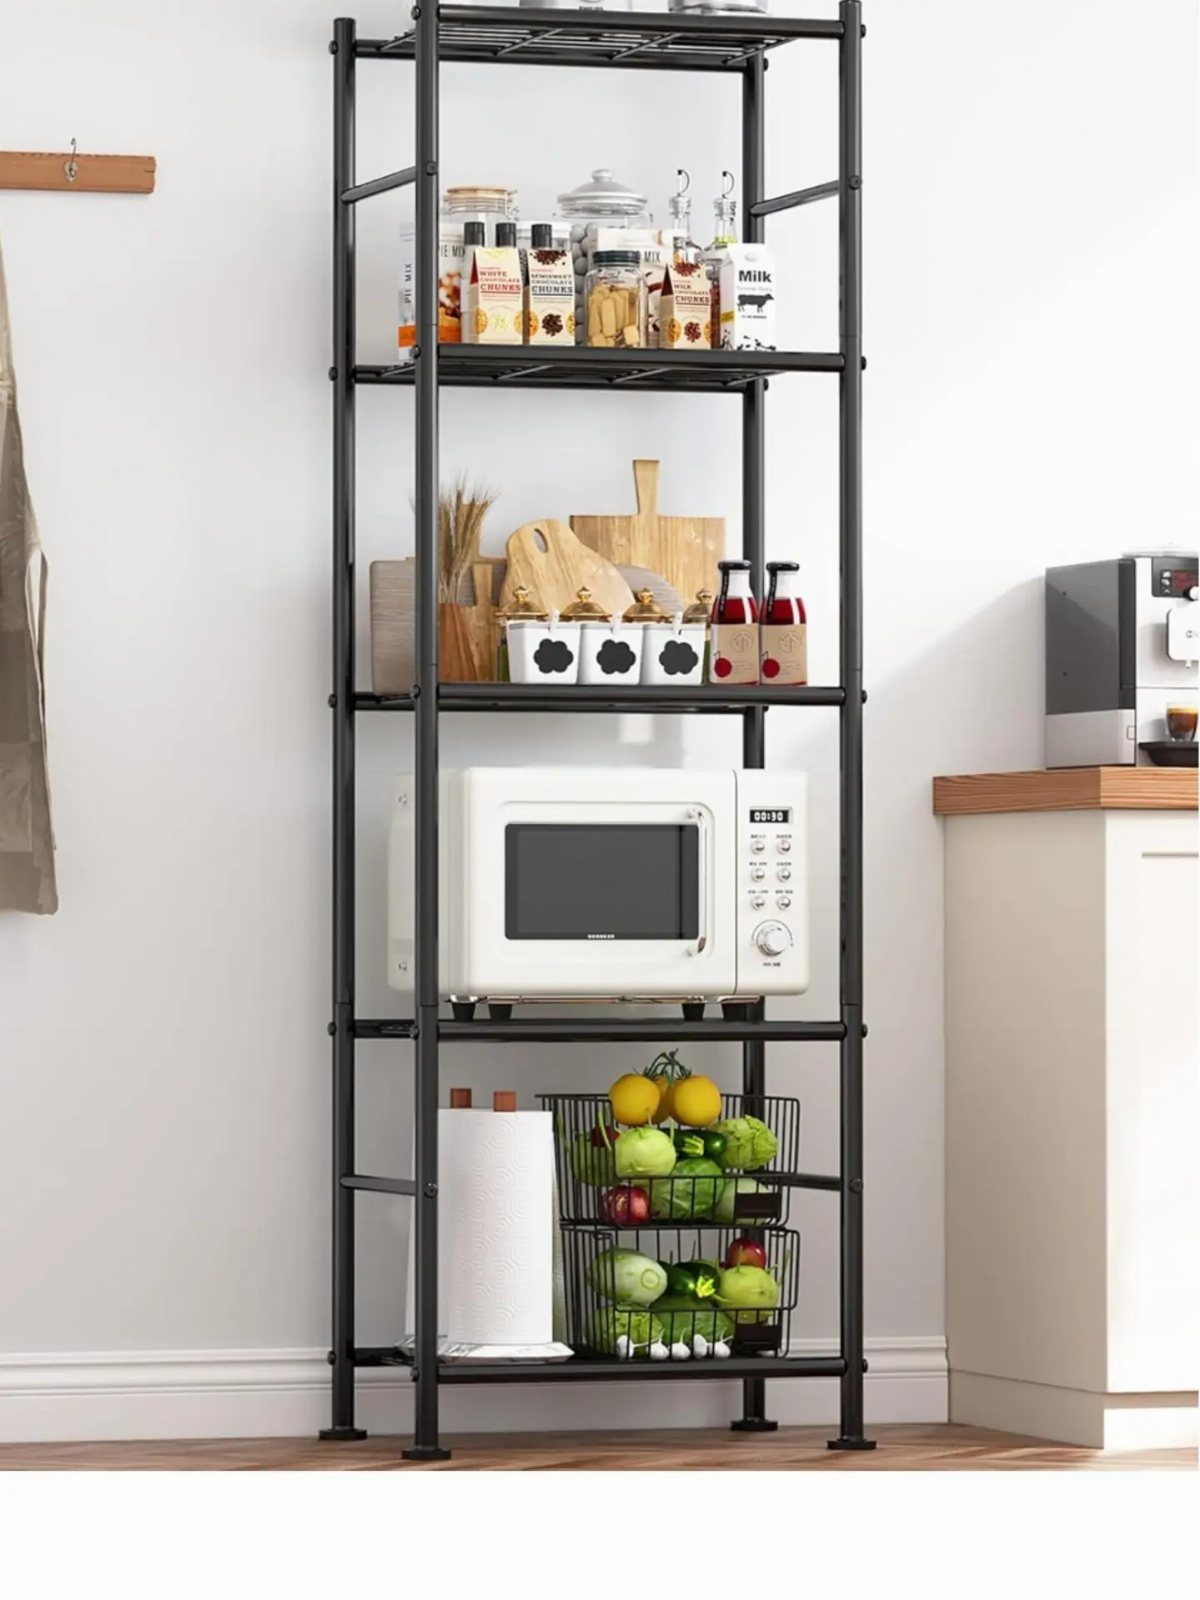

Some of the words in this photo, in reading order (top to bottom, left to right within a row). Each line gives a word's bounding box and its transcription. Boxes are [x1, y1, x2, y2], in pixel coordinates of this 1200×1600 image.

[644, 251, 662, 263] MIX
[404, 263, 412, 282] MIX
[739, 270, 772, 283] Milk
[480, 283, 521, 291] CHUNKS
[531, 285, 573, 293] CHUNKS
[675, 295, 710, 303] CHUNKS
[754, 811, 784, 822] 00:30
